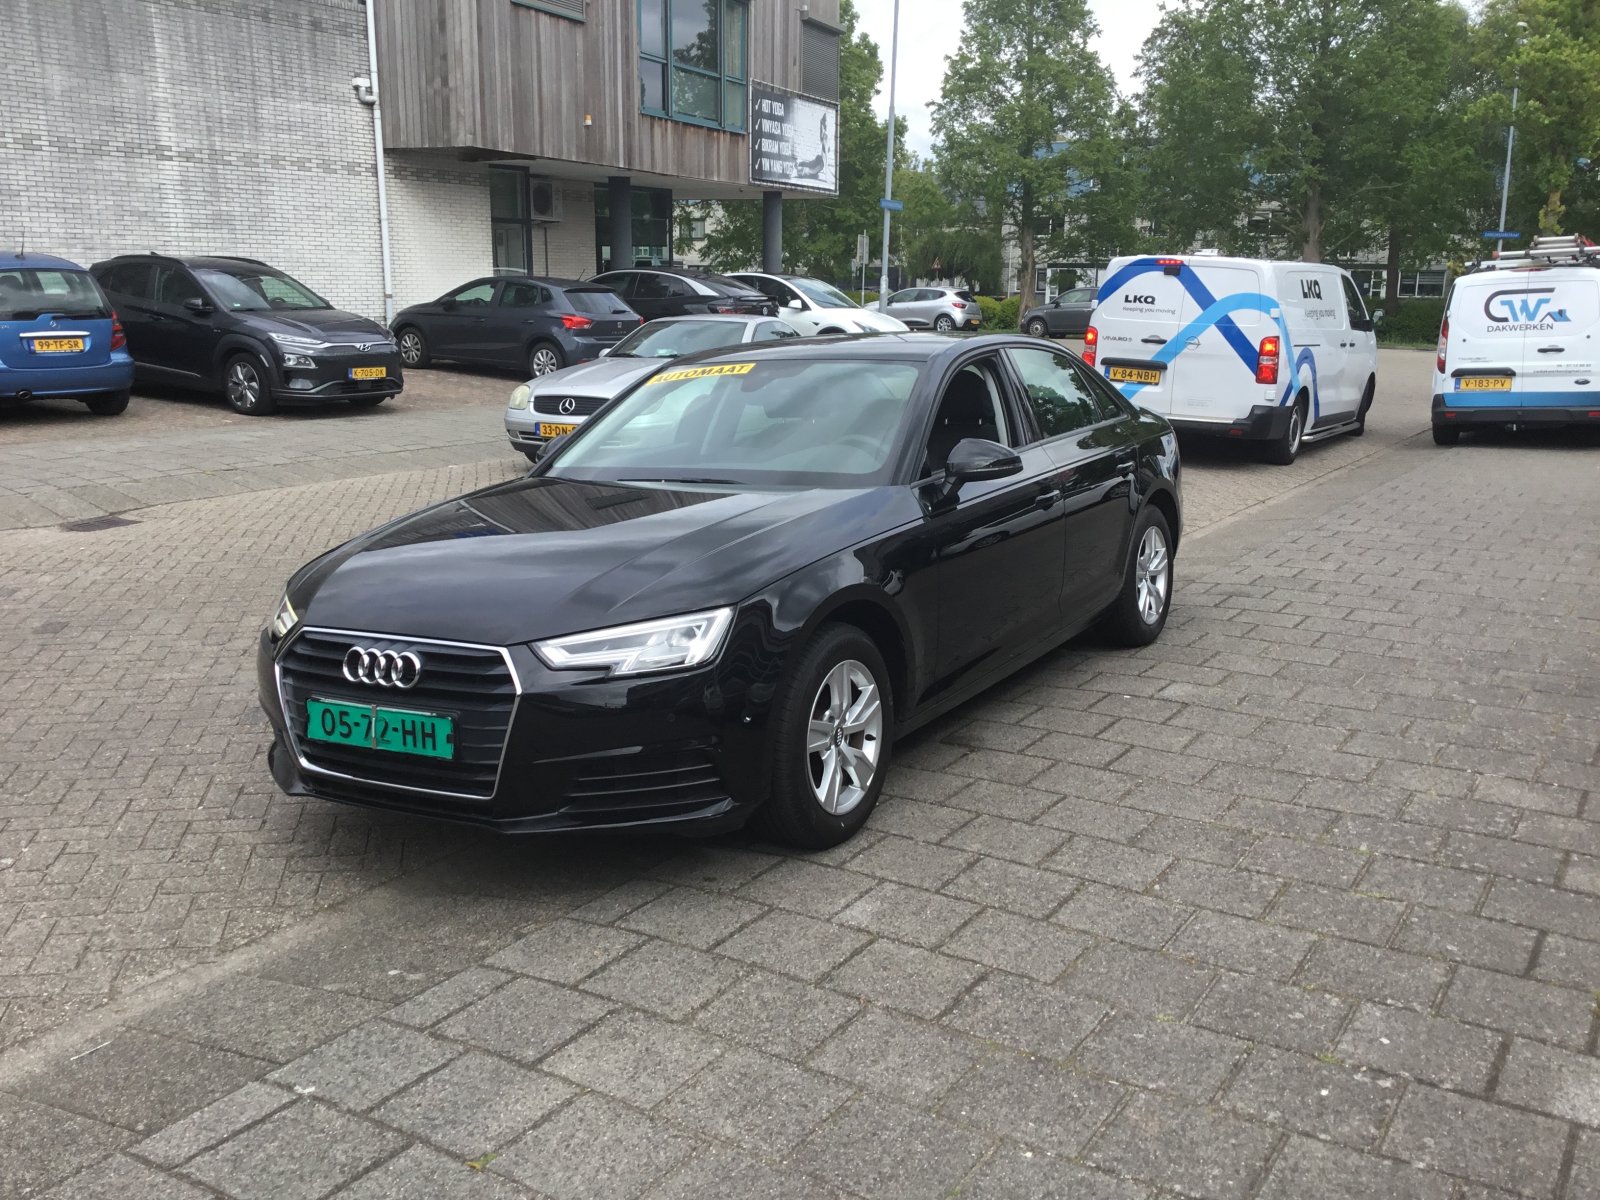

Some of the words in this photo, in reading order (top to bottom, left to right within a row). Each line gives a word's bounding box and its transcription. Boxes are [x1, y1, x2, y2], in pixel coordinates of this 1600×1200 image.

[761, 99, 771, 113] HOT
[771, 101, 784, 116] YOGA
[761, 118, 781, 135] VINYASA
[761, 138, 778, 154] BIKRAM
[779, 141, 791, 156] YOGA
[761, 158, 770, 171] YIN
[770, 160, 783, 173] YANG
[783, 162, 796, 175] YOGA
[1300, 279, 1323, 300] LKQ
[1124, 295, 1156, 305] LKQ
[1486, 323, 1554, 333] DAKWERKEN
[38, 341, 81, 349] 99-TF-SR
[353, 368, 384, 377] K-705-DK
[654, 365, 745, 382] AUTOMAAT
[1112, 369, 1157, 380] V-84-NBH
[1464, 379, 1507, 388] V-183-PV
[321, 708, 437, 751] 05-72-HH
